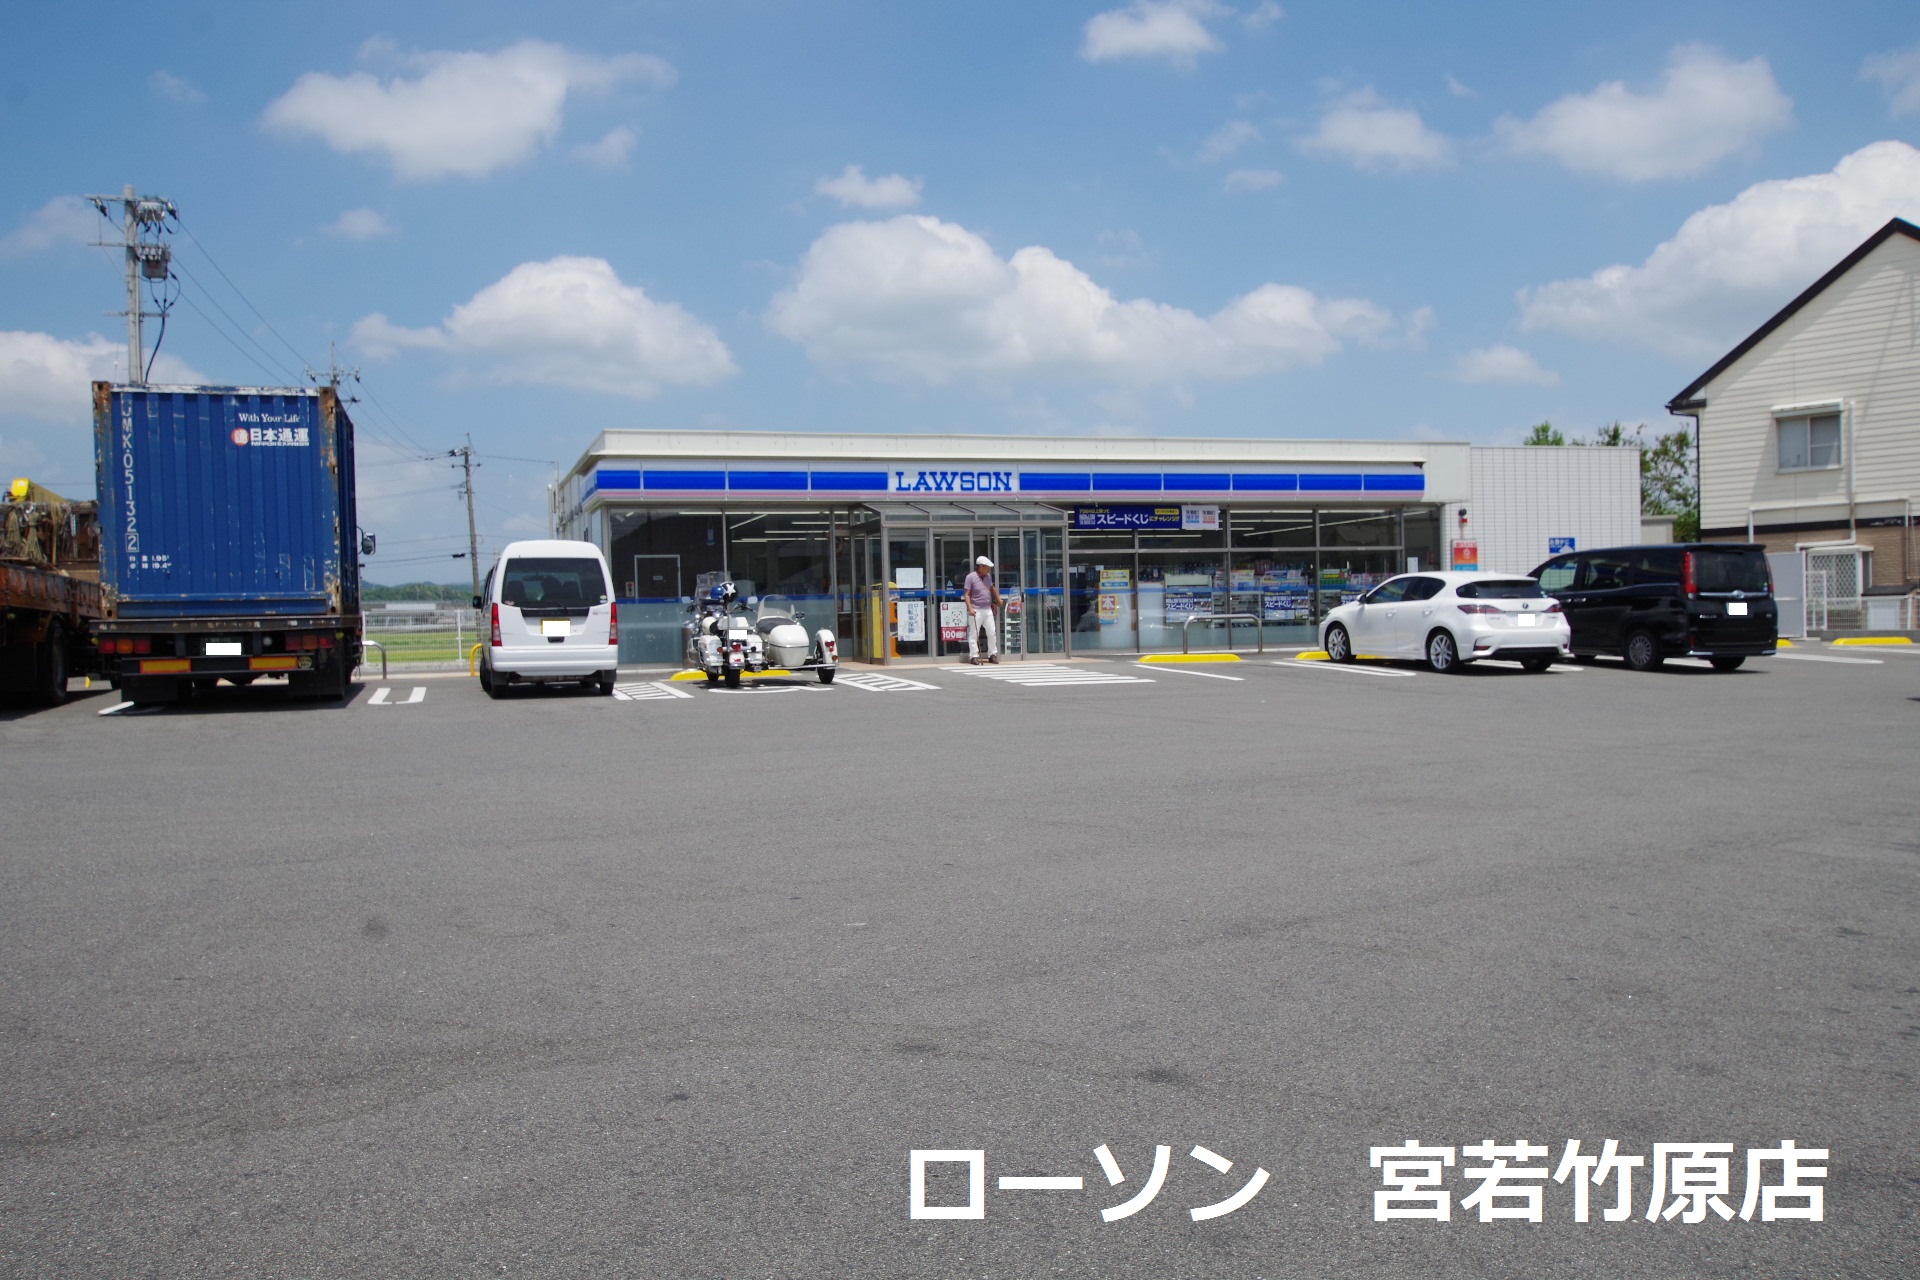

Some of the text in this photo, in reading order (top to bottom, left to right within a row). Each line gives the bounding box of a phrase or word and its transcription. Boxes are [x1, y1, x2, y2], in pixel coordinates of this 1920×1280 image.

[238, 412, 260, 422] With
[261, 412, 282, 422] Your
[250, 427, 310, 442] 日本通運
[895, 471, 1012, 491] LAWSON
[1096, 513, 1149, 525] スピードくじ
[942, 630, 956, 639] 100
